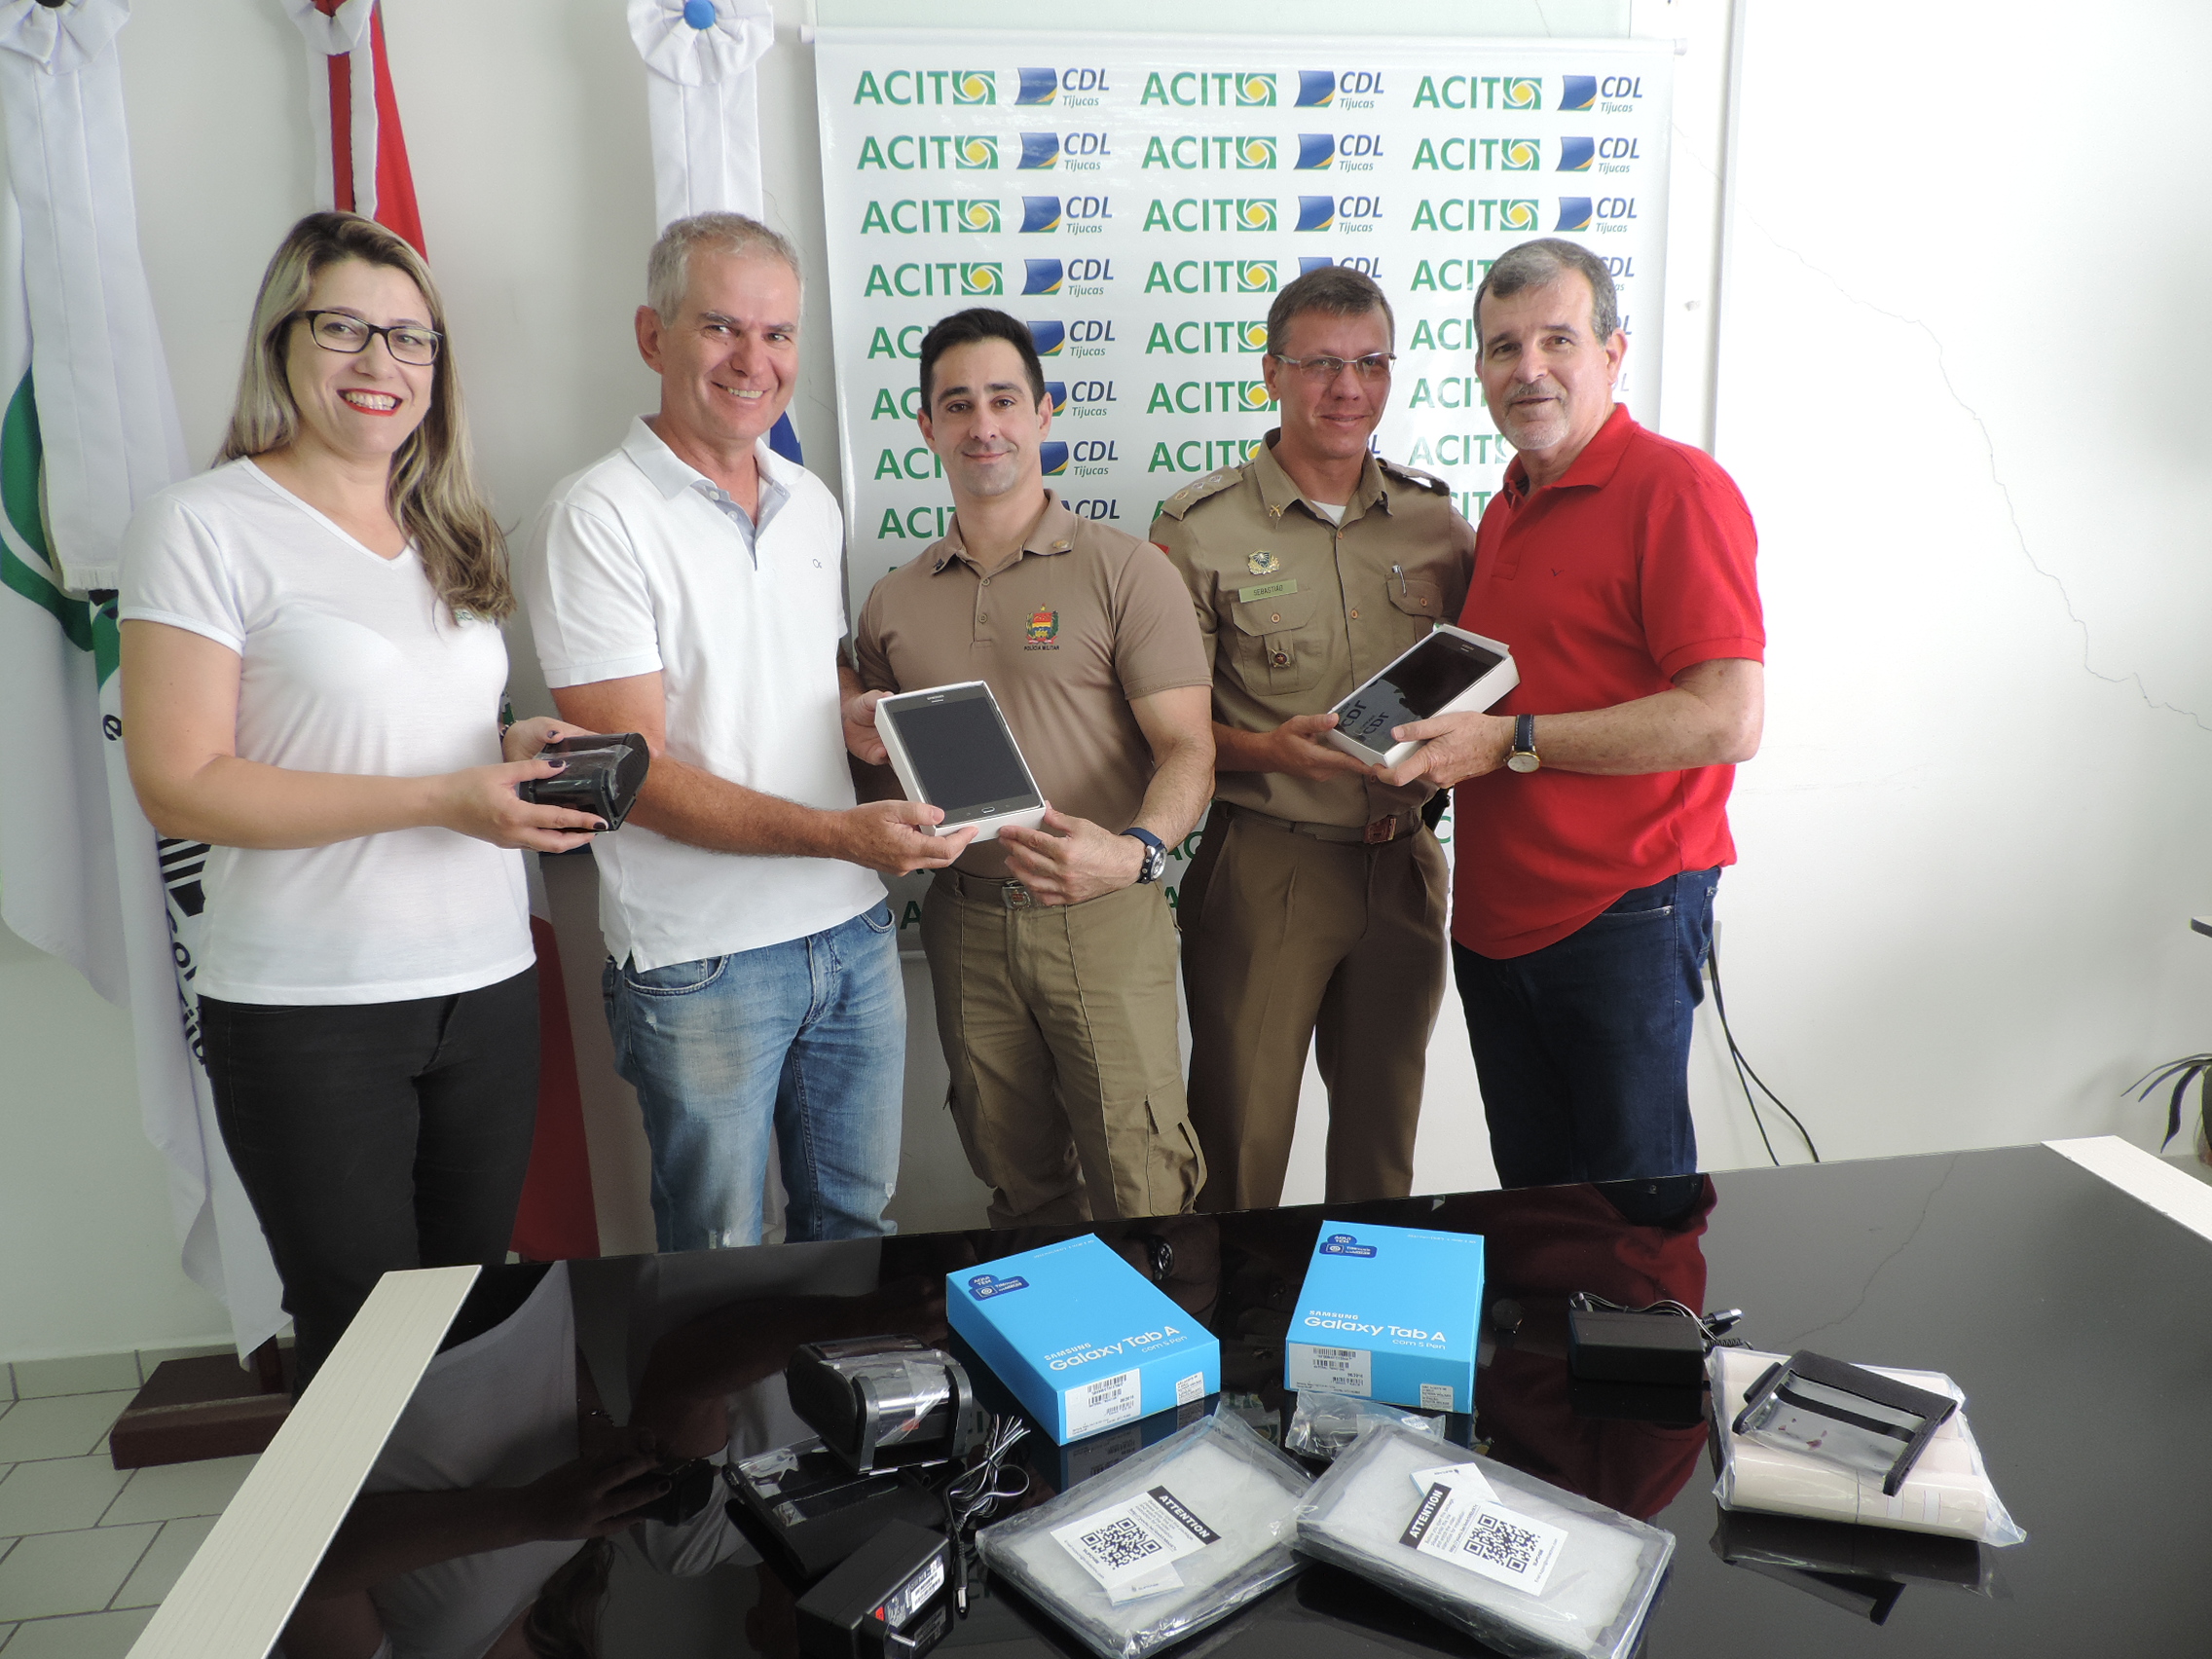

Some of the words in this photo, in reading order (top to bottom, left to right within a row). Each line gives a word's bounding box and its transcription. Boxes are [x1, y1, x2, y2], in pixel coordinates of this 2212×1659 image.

[1062, 68, 1109, 91] CDL
[1340, 71, 1383, 93] CDL
[1602, 76, 1642, 98] CDL
[1063, 95, 1098, 108] Tijucas
[1341, 98, 1374, 110] Tijucas
[1602, 102, 1632, 114] Tijucas
[1064, 132, 1110, 155] CDL
[1340, 134, 1383, 156] CDL
[1599, 137, 1640, 159] CDL
[1065, 160, 1100, 171] Tijucas
[1340, 161, 1373, 172] Tijucas
[1599, 163, 1630, 174] Tijucas
[1066, 197, 1112, 219] CDL
[1339, 196, 1382, 218] CDL
[1597, 198, 1637, 218] CDL
[1068, 223, 1102, 235] Tijucas
[1340, 223, 1373, 234] Tijucas
[1597, 223, 1627, 234] Tijucas
[1068, 259, 1114, 281] CDL
[1602, 256, 1635, 276] DL
[1069, 285, 1103, 297] Tijucas
[1070, 320, 1115, 342] CDL
[1410, 318, 1472, 350] ACI
[867, 325, 922, 359] AC
[1071, 347, 1105, 358] Tijucas
[1072, 381, 1117, 402] CDL
[870, 387, 921, 420] AC
[1072, 407, 1106, 419] Tijucas
[1073, 440, 1118, 461] CDL
[874, 447, 941, 480] ACI
[1075, 466, 1108, 477] Tijucas
[1075, 499, 1121, 520] CDL
[1309, 1309, 1358, 1320] SAMSUNG
[1305, 1316, 1383, 1336] Galaxy
[1387, 1325, 1427, 1340] Tab
[1431, 1331, 1446, 1343] A
[1044, 1343, 1092, 1360] SAMSUNG
[1050, 1343, 1124, 1371] Galaxy
[1123, 1331, 1162, 1347] Tab
[1163, 1325, 1180, 1337] A
[1141, 1342, 1163, 1353] com
[1169, 1336, 1188, 1345] Pen
[1158, 1494, 1210, 1538] ATTENTION
[1409, 1489, 1443, 1538] ATTENTION
